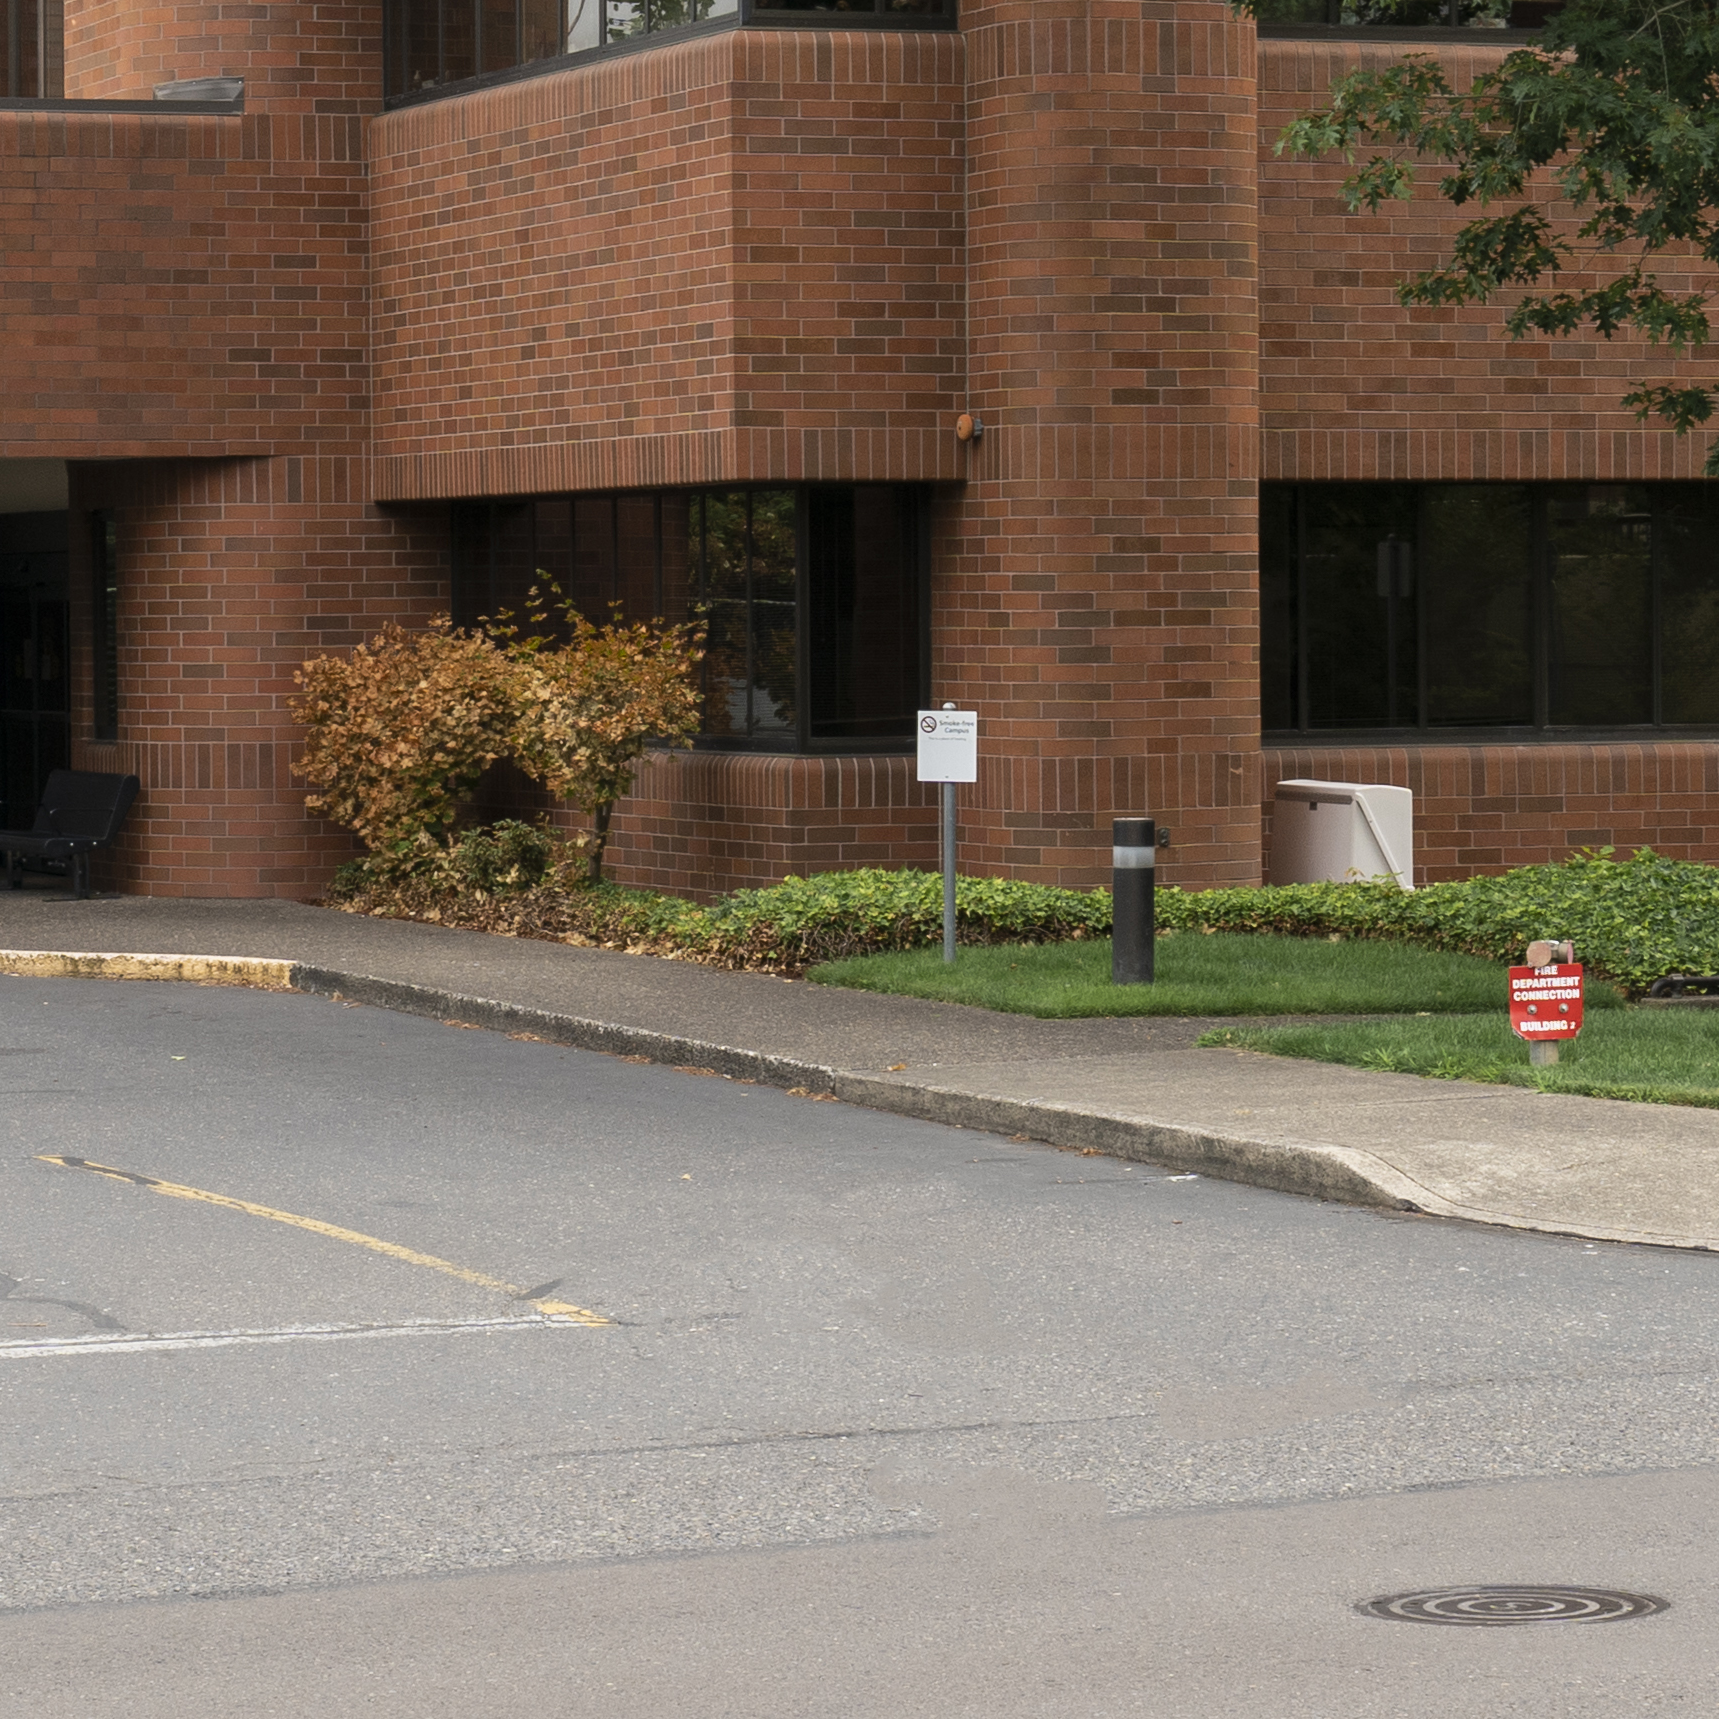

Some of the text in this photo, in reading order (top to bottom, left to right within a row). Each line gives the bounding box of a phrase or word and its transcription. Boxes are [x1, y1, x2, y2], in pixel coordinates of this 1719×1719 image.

[1534, 965, 1558, 975] FIRE
[1512, 976, 1580, 989] DEPARTMENT
[1513, 989, 1580, 1001] CONNECTION
[1520, 1020, 1568, 1031] BUILDING
